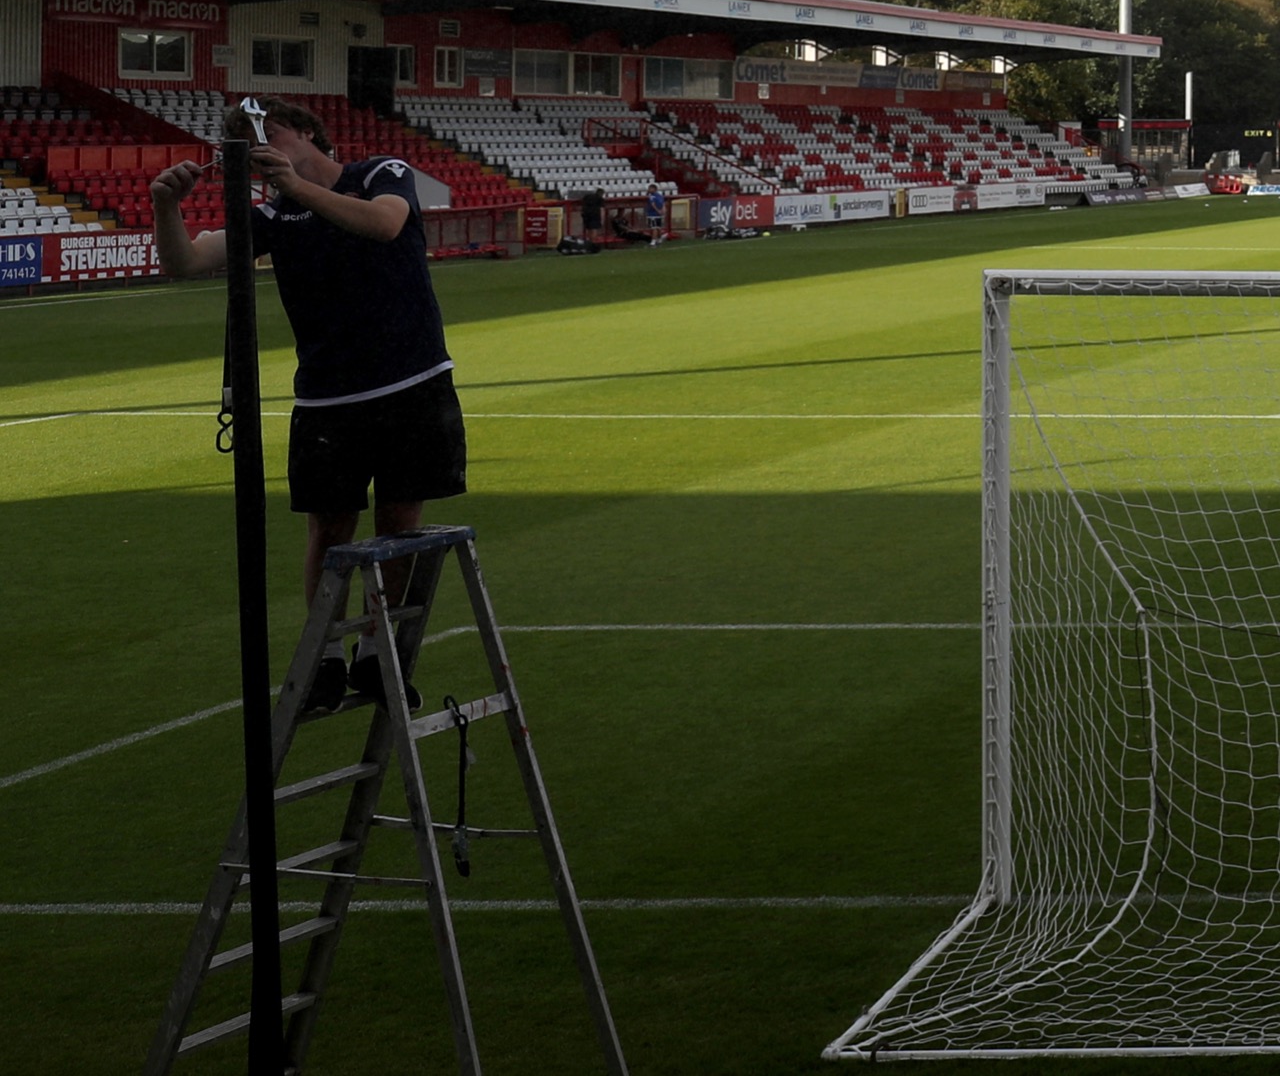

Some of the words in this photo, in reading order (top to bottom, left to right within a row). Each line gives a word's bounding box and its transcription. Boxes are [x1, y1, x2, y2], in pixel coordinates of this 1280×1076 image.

[148, 0, 220, 22] macron
[736, 57, 787, 82] Comet
[900, 68, 938, 89] Comet
[280, 210, 313, 222] acron
[709, 201, 732, 225] sky
[735, 200, 758, 221] bet
[61, 237, 94, 249] BURGER
[96, 235, 117, 248] KING
[118, 234, 141, 246] HOME
[142, 233, 153, 245] OF
[60, 245, 147, 272] STEVENAGE
[150, 245, 160, 266] F.
[1, 266, 36, 280] 741412
